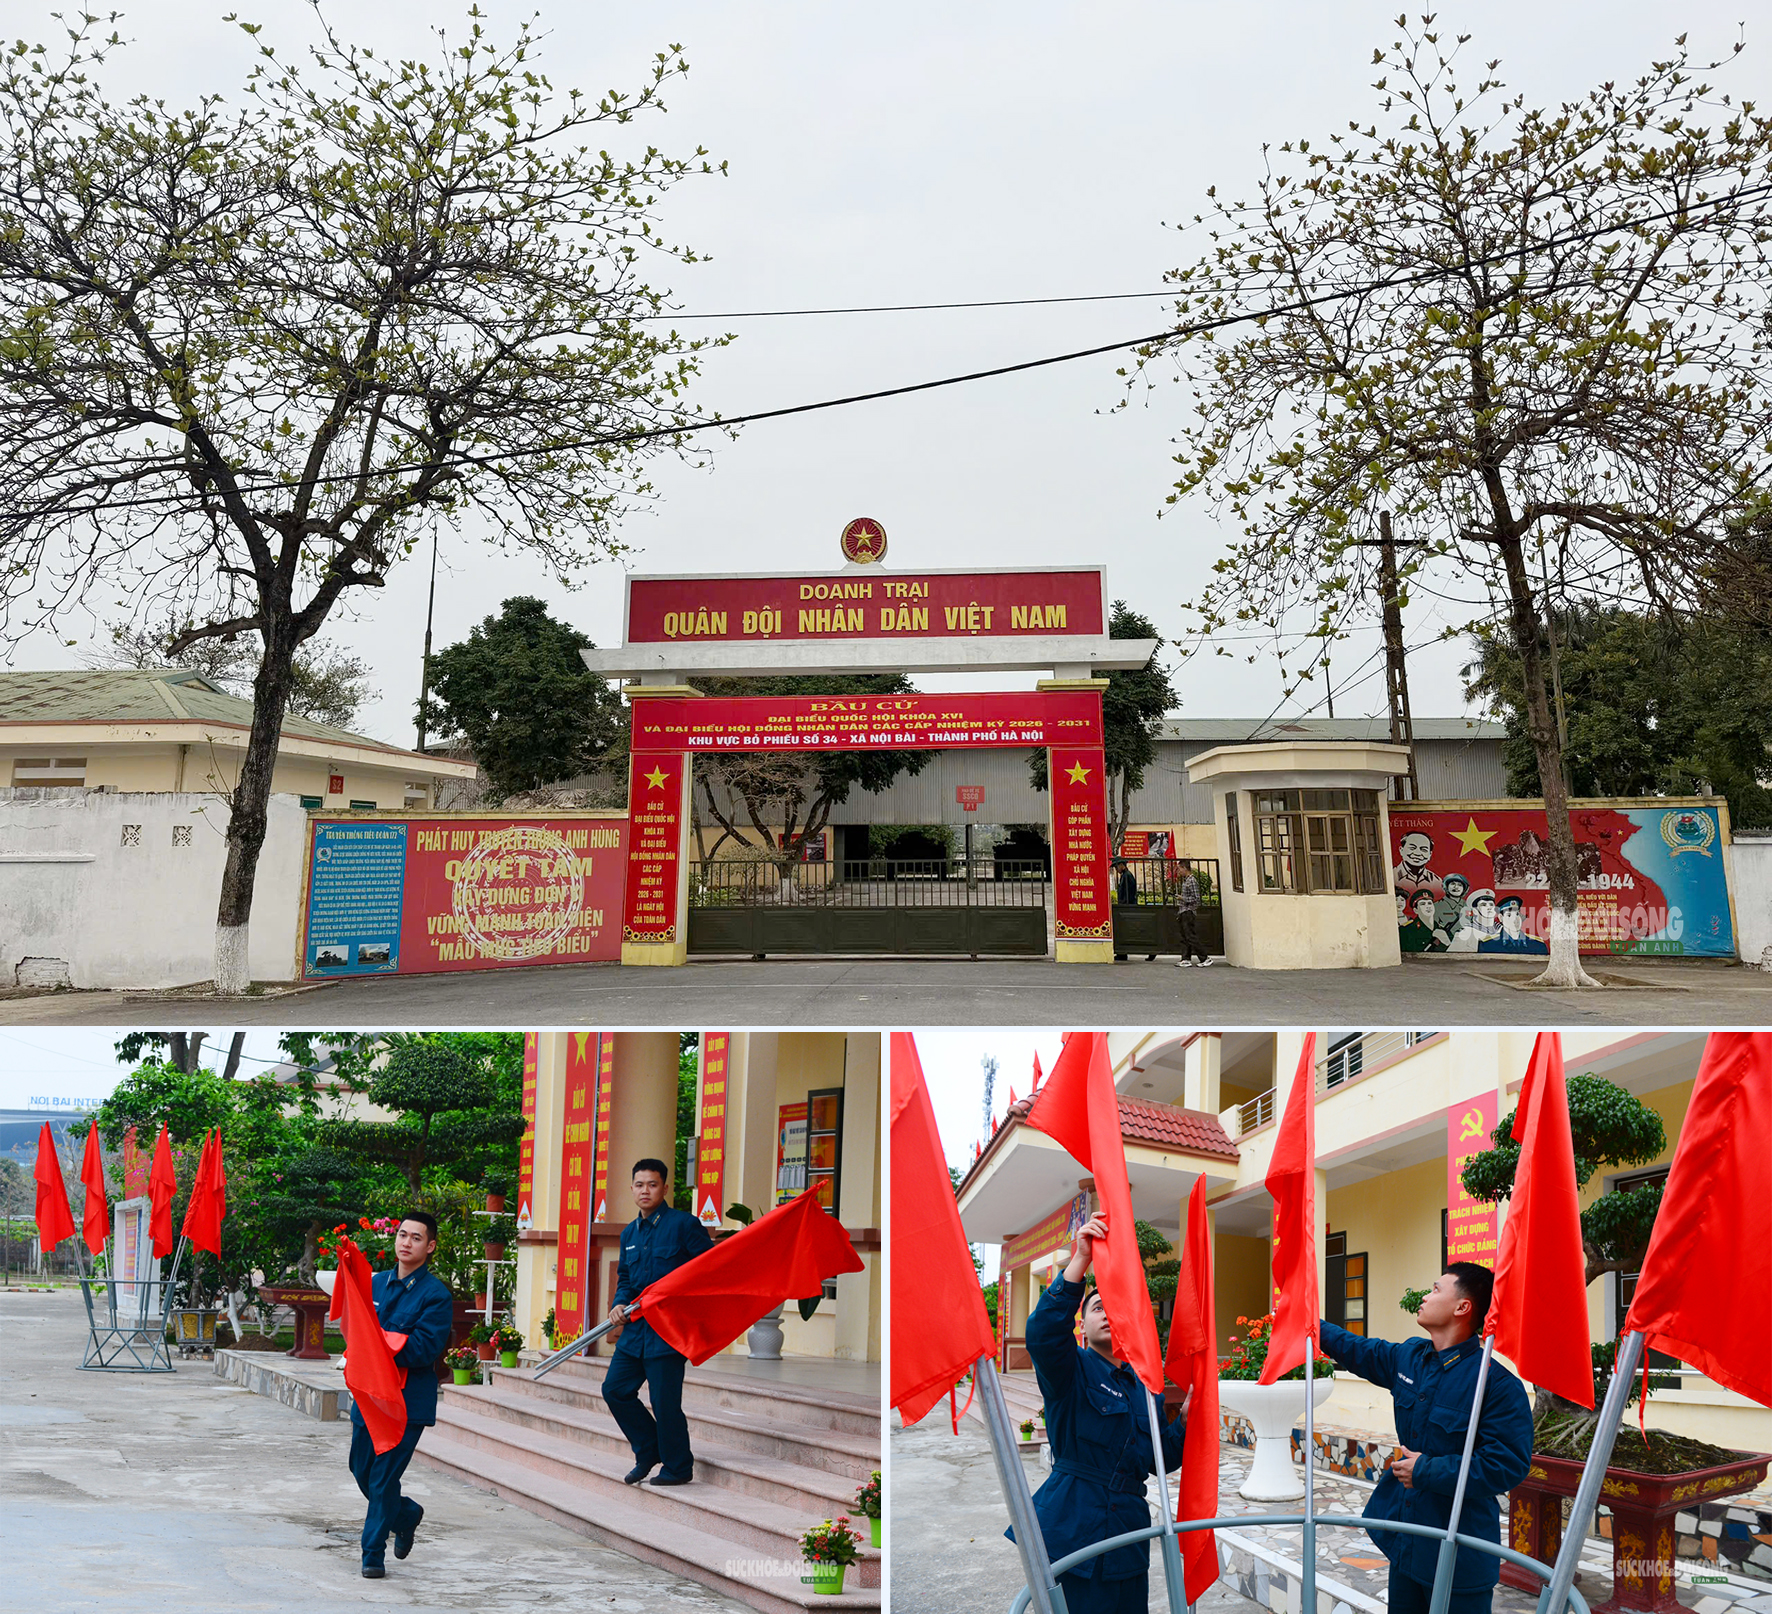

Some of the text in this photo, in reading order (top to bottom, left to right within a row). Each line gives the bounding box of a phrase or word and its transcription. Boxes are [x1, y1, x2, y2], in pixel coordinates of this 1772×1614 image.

[800, 582, 929, 603] DOANH TRẠI
[663, 601, 1067, 639] QUÂN ĐỘI NHÂN DÂN VIỆT NAM
[877, 700, 918, 709] CỬ
[665, 725, 689, 734] ĐẠI
[692, 722, 724, 732] BIỂU
[728, 724, 751, 733] HỘI
[755, 722, 793, 732] ĐỒNG
[797, 722, 836, 731] NHÂN
[840, 722, 869, 731] DÂN
[872, 720, 901, 730] CÁC
[905, 719, 933, 730] CẤP
[936, 720, 981, 730] NHIỆM
[986, 719, 1007, 729] KỲ
[1008, 719, 1043, 728] 2026
[1056, 719, 1092, 727] 2031
[768, 712, 964, 725] ĐẠI BIỂU QUỐC HỘI KHÓA XVI
[688, 730, 1043, 747] KHU VỰC BỎ PHIẾU SỐ 34 XÃ NỘI BÀI THÀNH PHỐ HÀ NỘI
[417, 827, 448, 851] PHÁT
[451, 831, 475, 851] HUY
[565, 830, 588, 848] ANH
[591, 825, 620, 848] HÙNG
[445, 853, 593, 884] QUYẾT TÂM
[489, 886, 532, 909] DỰNG
[53, 1096, 71, 1106] BAI
[1449, 1202, 1496, 1220] TRÁCH NHIỆM
[1454, 1221, 1489, 1237] XÂY DỰNG
[1447, 1237, 1497, 1256] TỔ CHỨC ĐẢNG
